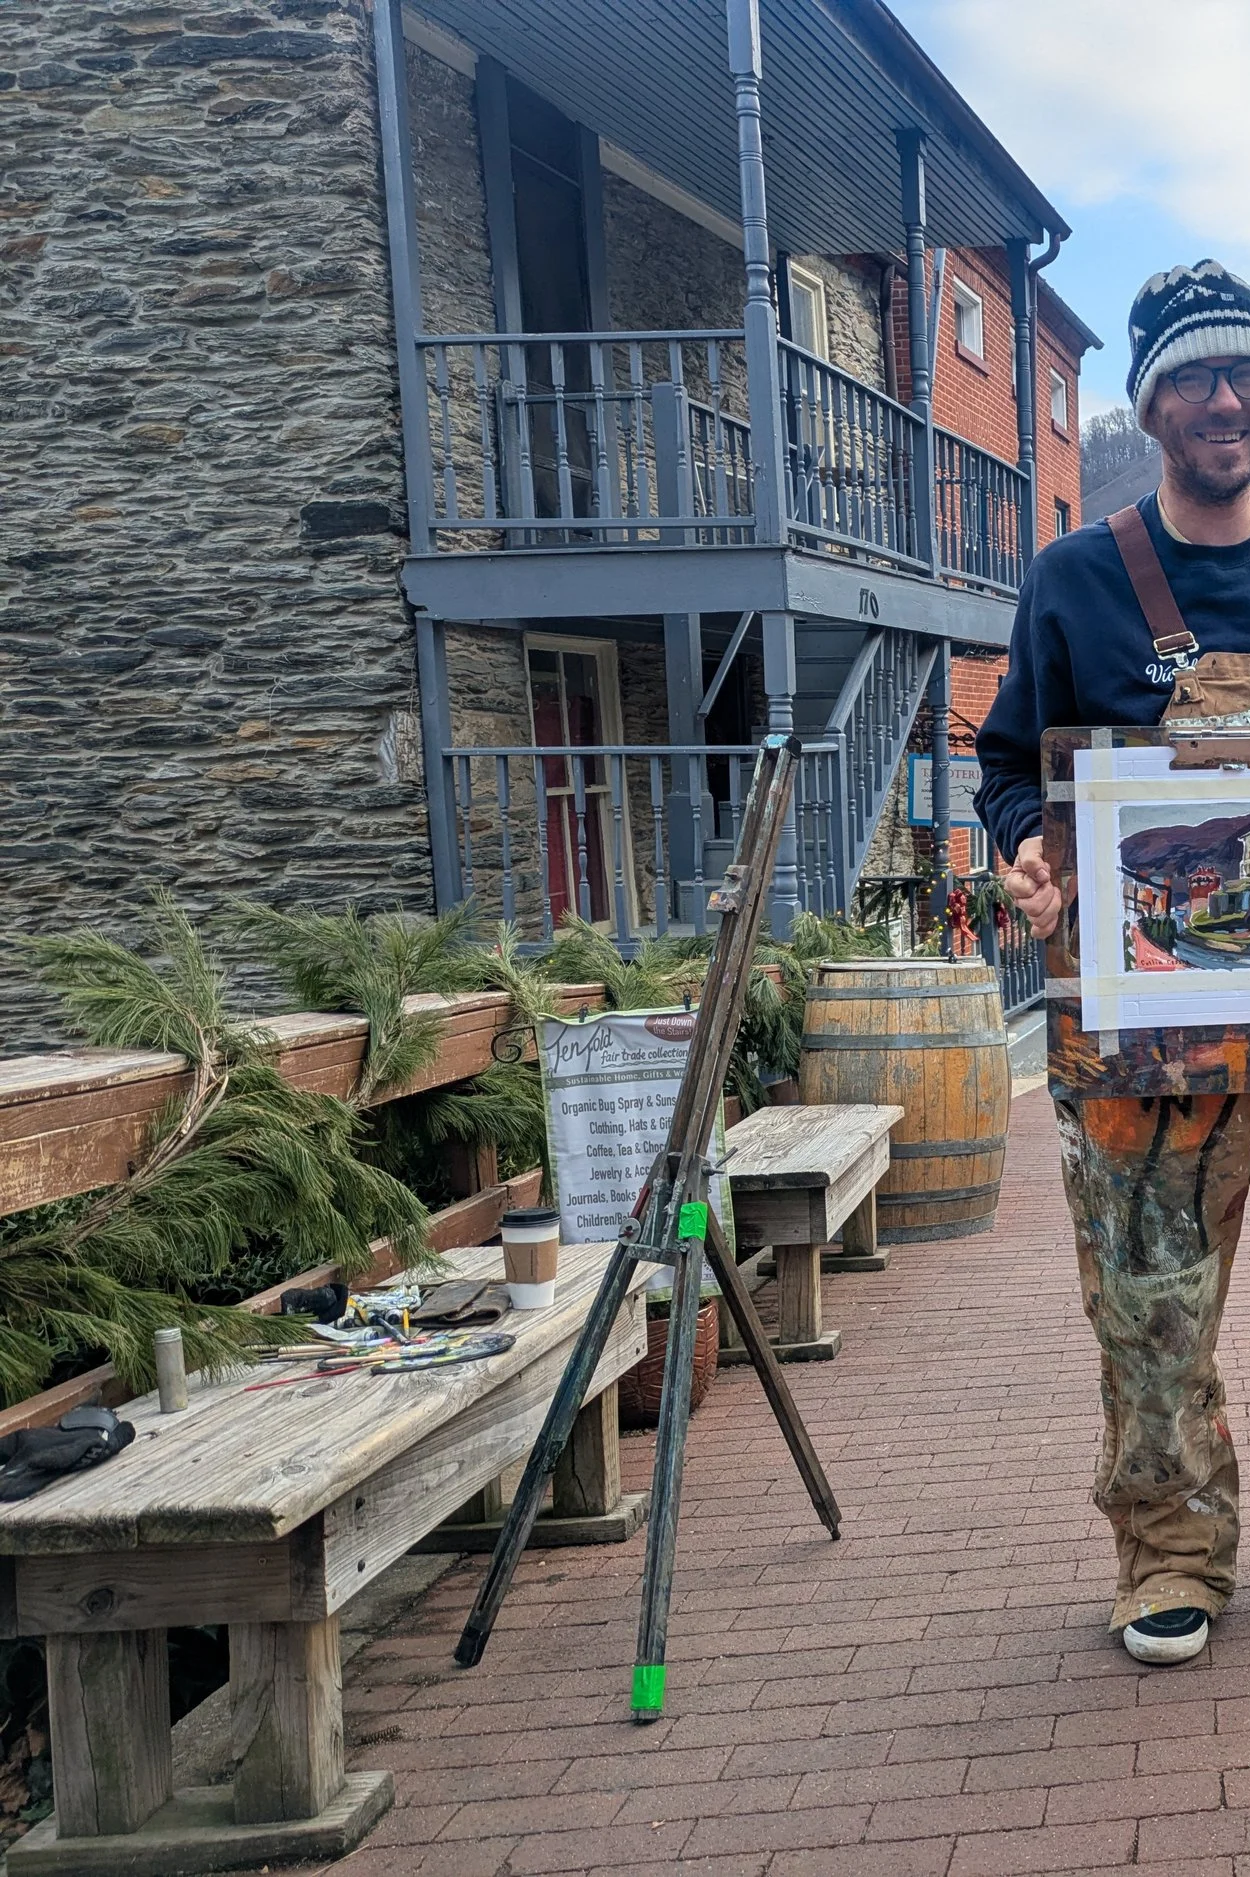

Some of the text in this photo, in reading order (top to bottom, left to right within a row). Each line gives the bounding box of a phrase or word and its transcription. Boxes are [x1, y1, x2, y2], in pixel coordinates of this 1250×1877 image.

[859, 587, 879, 619] 170
[653, 1016, 692, 1027] Just Down
[653, 1026, 666, 1035] the
[600, 1050, 620, 1065] fair
[621, 1047, 646, 1061] trade
[566, 1074, 612, 1086] Sustainable
[643, 1070, 664, 1080] Gifts
[666, 1070, 672, 1078] &
[561, 1093, 676, 1117] Organic Bug Spray & Suns
[589, 1116, 673, 1136] Clothing, Hats & Gif
[586, 1140, 666, 1158] Coffee, Tea & Choc
[589, 1164, 651, 1182] Jewelry & Acc
[566, 1188, 637, 1207] Journals, Books
